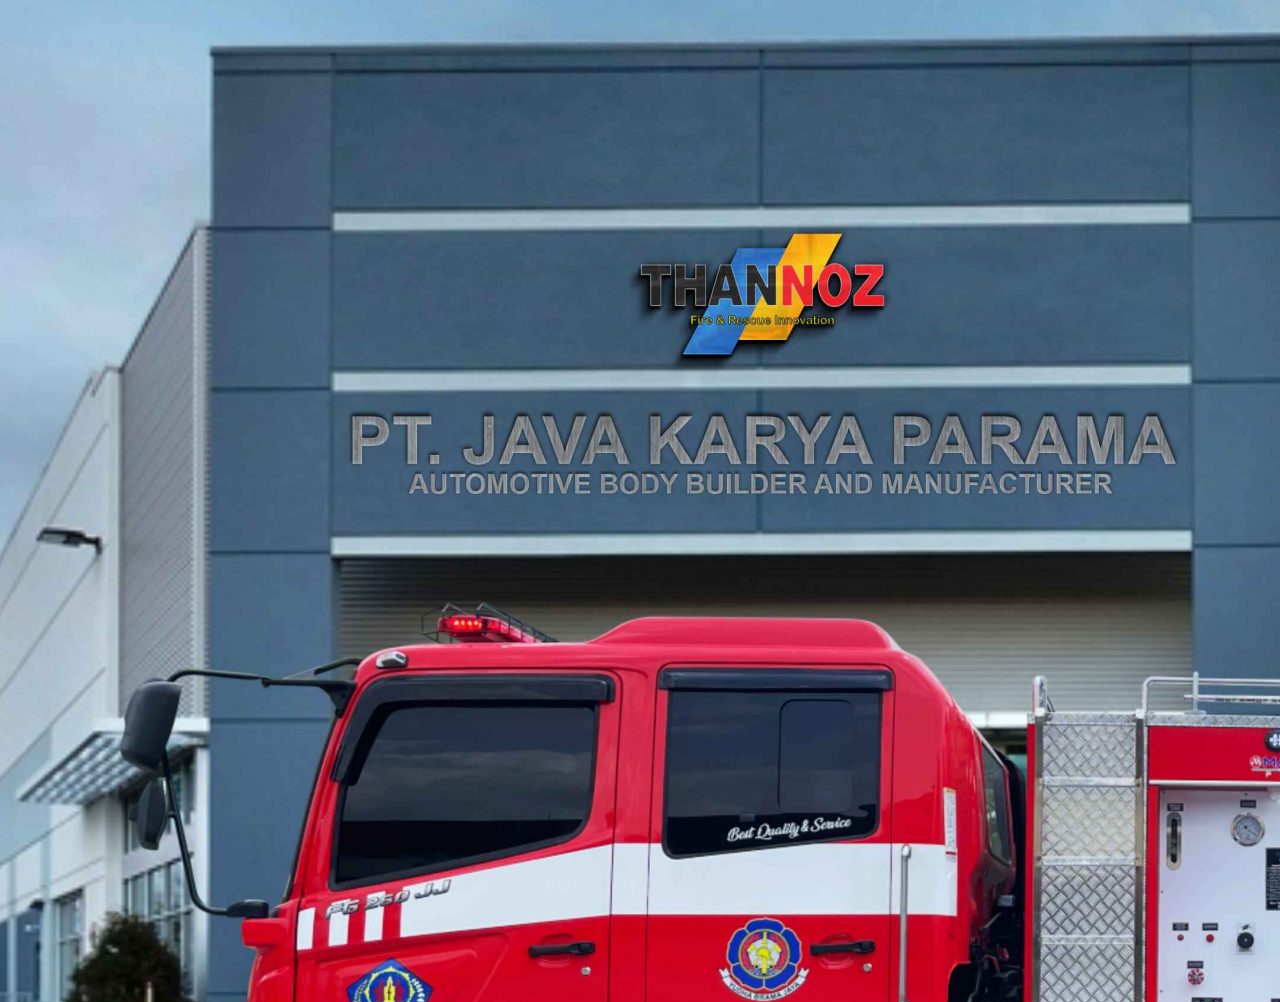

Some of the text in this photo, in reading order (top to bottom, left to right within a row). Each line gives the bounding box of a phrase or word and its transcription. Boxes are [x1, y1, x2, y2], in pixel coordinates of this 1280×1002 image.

[640, 263, 885, 308] THANNOZ
[690, 315, 836, 326] Fire & Rescue Innovation
[351, 415, 1177, 466] PT. JAVA KARYA PARAMA
[408, 472, 1113, 495] AUTOMOTIVE BODY BUILDER AND MANUFACTURER
[727, 816, 852, 842] Best Quality & Service
